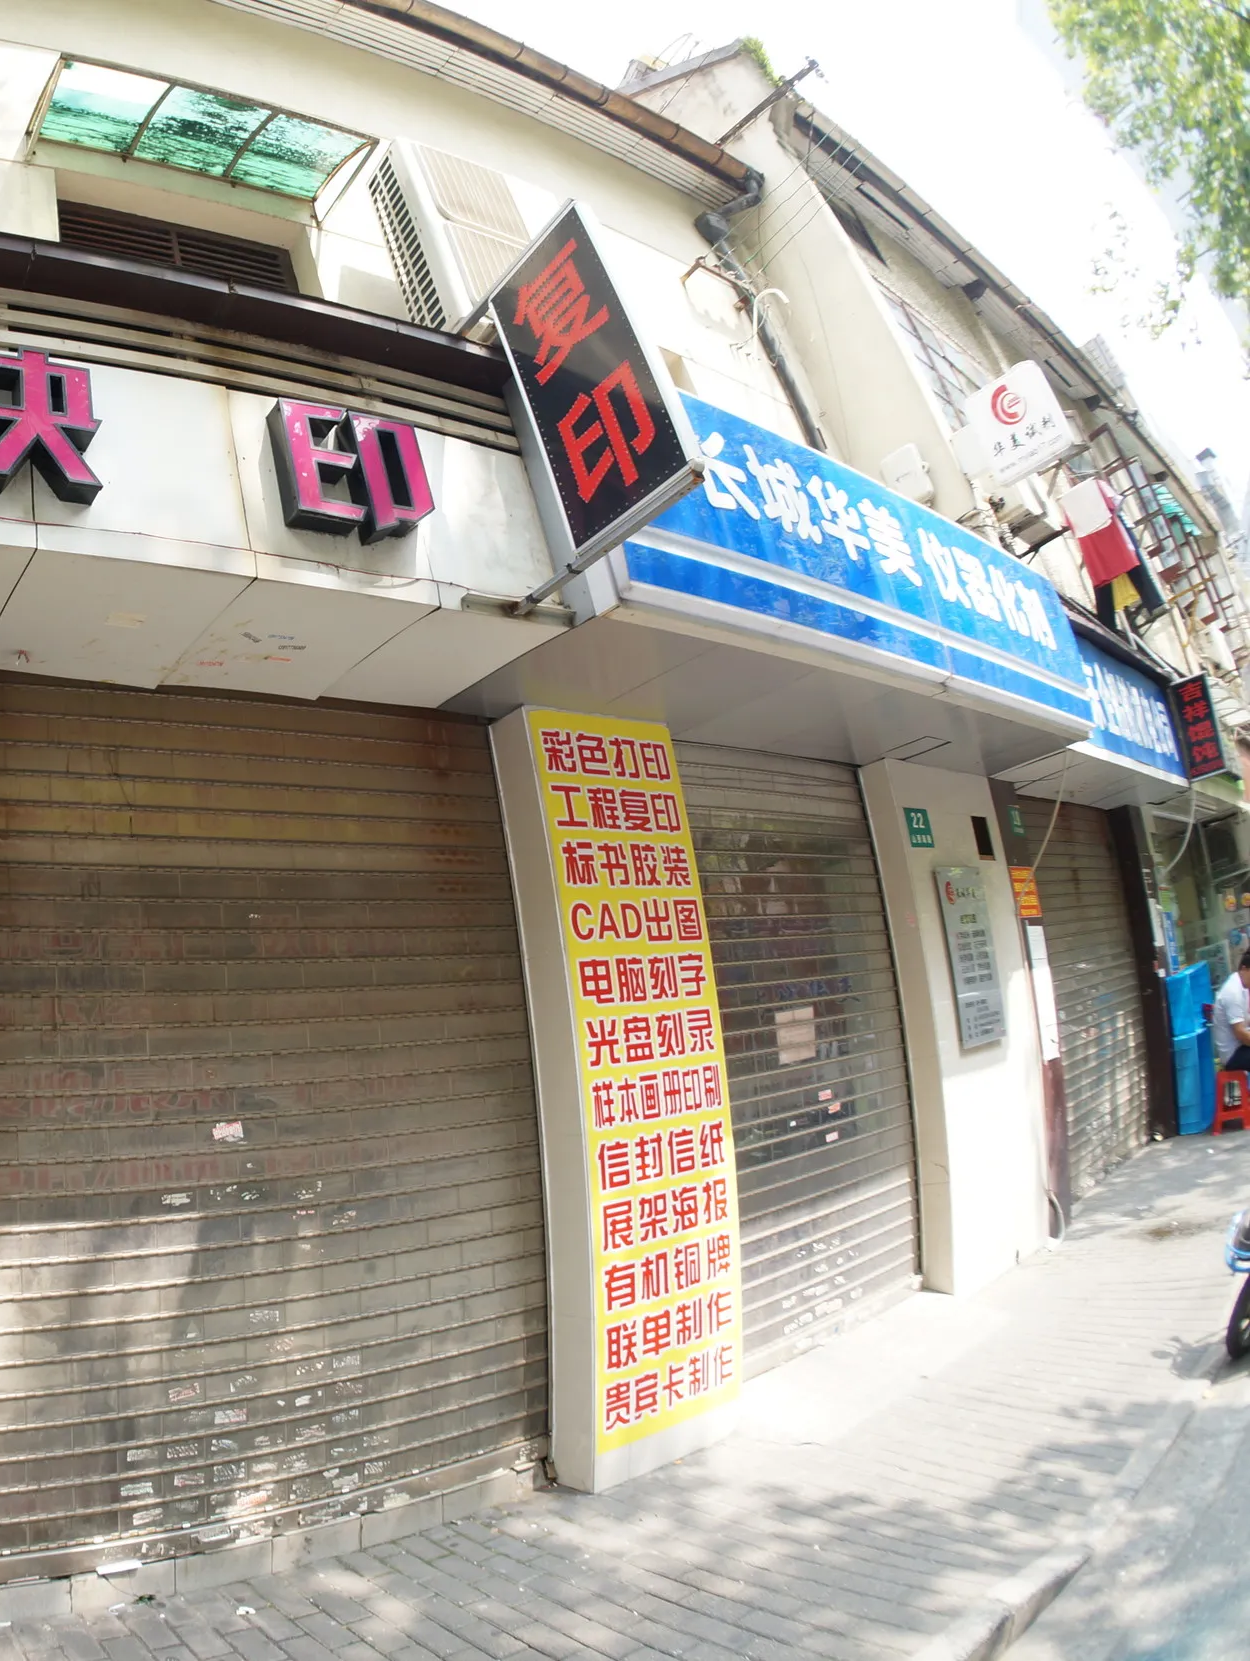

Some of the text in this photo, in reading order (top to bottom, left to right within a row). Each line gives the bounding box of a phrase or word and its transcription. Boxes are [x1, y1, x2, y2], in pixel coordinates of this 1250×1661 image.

[513, 237, 656, 504] 复印
[540, 730, 671, 781] 彩色打印
[550, 784, 682, 833] 工程复印
[910, 812, 926, 829] 22
[562, 842, 692, 887] 标书胶装
[571, 899, 703, 942] CAD出图
[578, 954, 707, 1004] 电脑刻字
[585, 1009, 715, 1067] 光盘刻录
[592, 1065, 722, 1129] 样本画册印刷
[598, 1121, 725, 1190] 信封信纸
[603, 1178, 728, 1251] 展架海报
[605, 1234, 730, 1311] 有机铜牌
[606, 1291, 732, 1370] 联单制作
[605, 1345, 733, 1431] 贵宾卡制作
